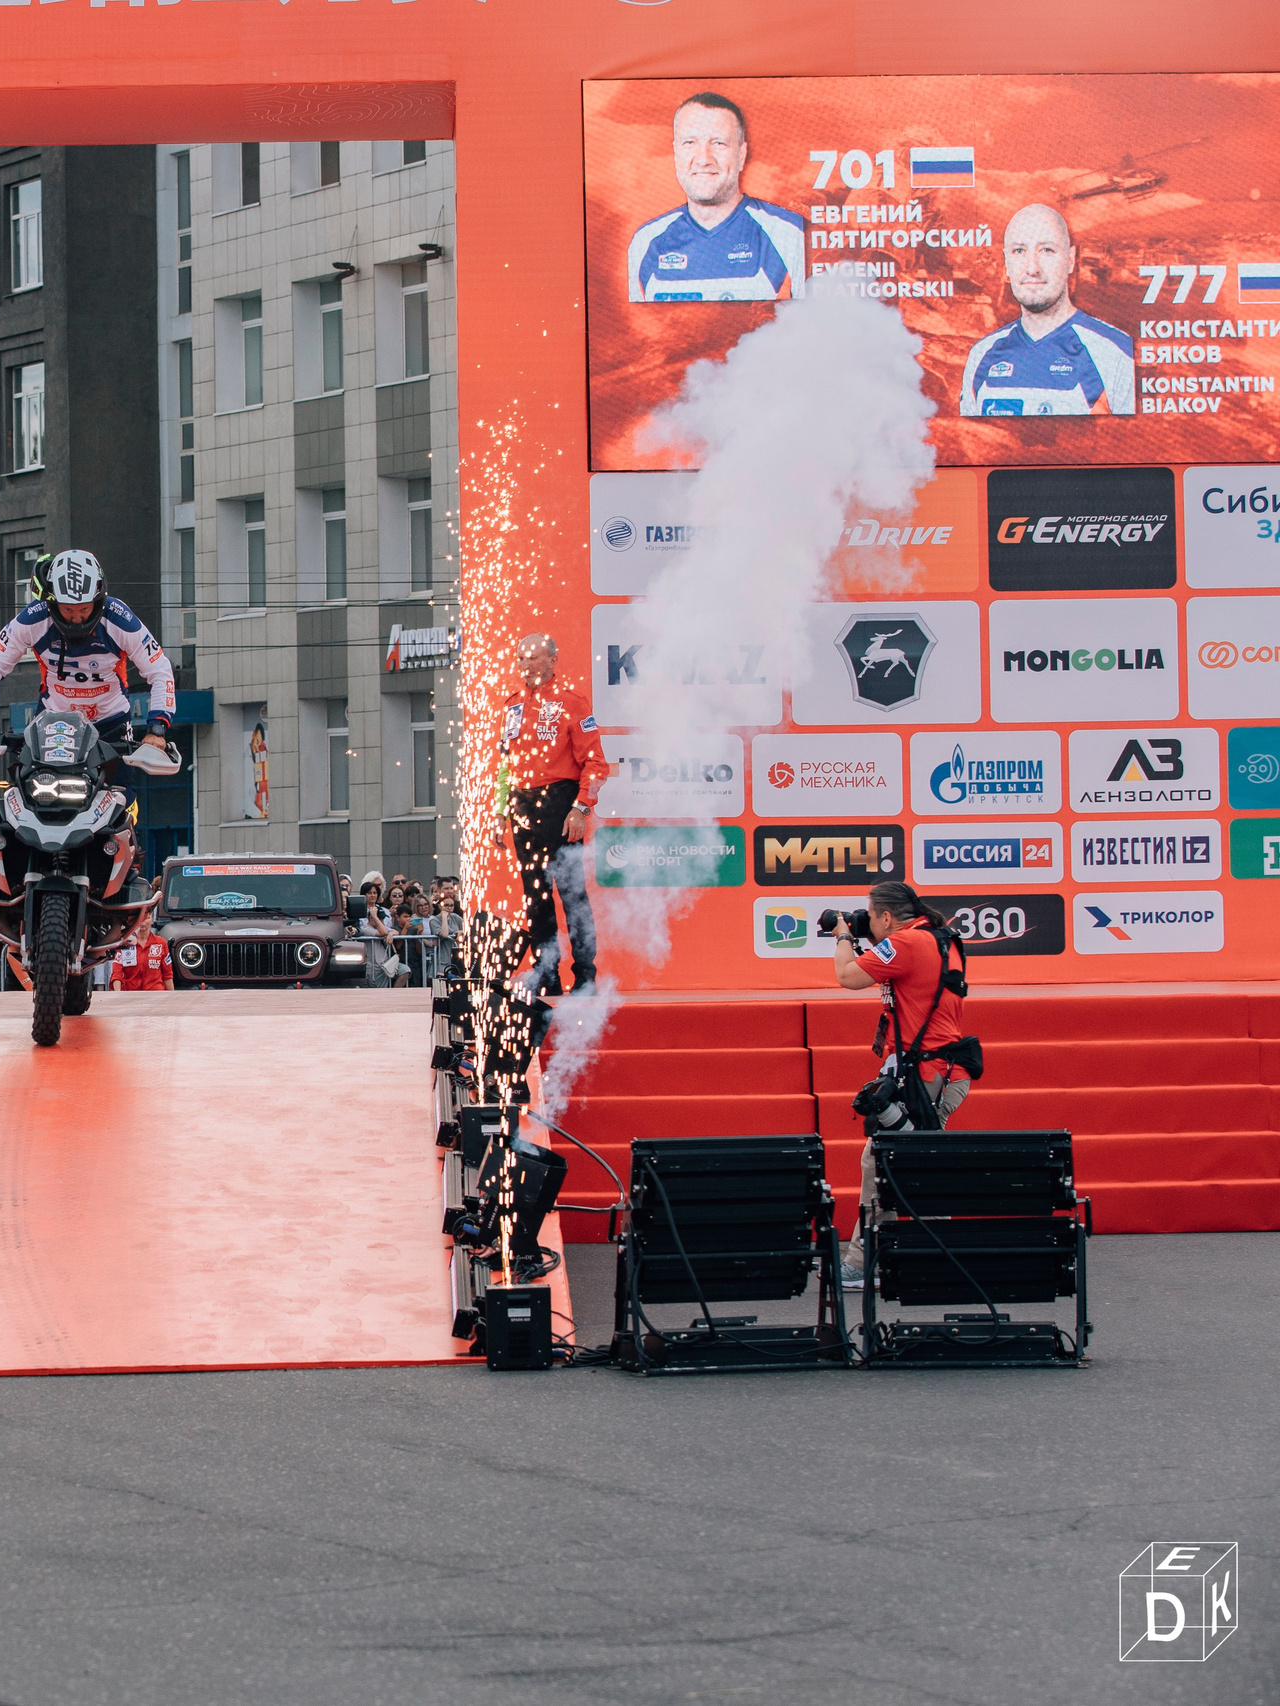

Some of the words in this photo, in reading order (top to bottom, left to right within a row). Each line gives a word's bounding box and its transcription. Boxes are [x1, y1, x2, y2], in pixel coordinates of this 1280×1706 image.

[809, 149, 895, 190] 701
[810, 199, 922, 224] ЕВГЕНИЙ
[810, 224, 992, 249] ПЯТИГОРСКИЙ
[811, 262, 896, 278] EVGENII
[1138, 265, 1227, 304] 777
[1140, 345, 1222, 364] БЯКОВ
[1141, 376, 1275, 393] KONSTANTIN
[1142, 396, 1222, 414] BIAKOV
[1066, 515, 1128, 523] МОТОРНОЕ
[1130, 514, 1168, 522] МАСЛО
[1003, 648, 1165, 672] MONGOLIA
[536, 725, 558, 733] SILK
[536, 732, 558, 741] WAY
[629, 757, 733, 783] Delko
[800, 761, 875, 775] РУССКАЯ
[968, 760, 1043, 781] ГАЗПРОМ
[800, 775, 887, 788] МЕХАНИКА
[970, 783, 1042, 793] ДОБЫЧА
[968, 794, 1044, 804] ИРКУТСК
[1080, 789, 1212, 803] ЛЕНЗОЛОТО
[637, 845, 667, 856] РИА
[670, 844, 735, 857] НОВОСТИ
[764, 836, 894, 874] МАТЧ!
[932, 844, 1013, 863] РОССИЯ
[1025, 843, 1049, 861] 24
[1082, 836, 1177, 866] ИЗВЕСТИЯ
[637, 856, 682, 867] СПОРТ
[954, 906, 1026, 939] 360
[1120, 910, 1215, 925] ТРИКОЛОР
